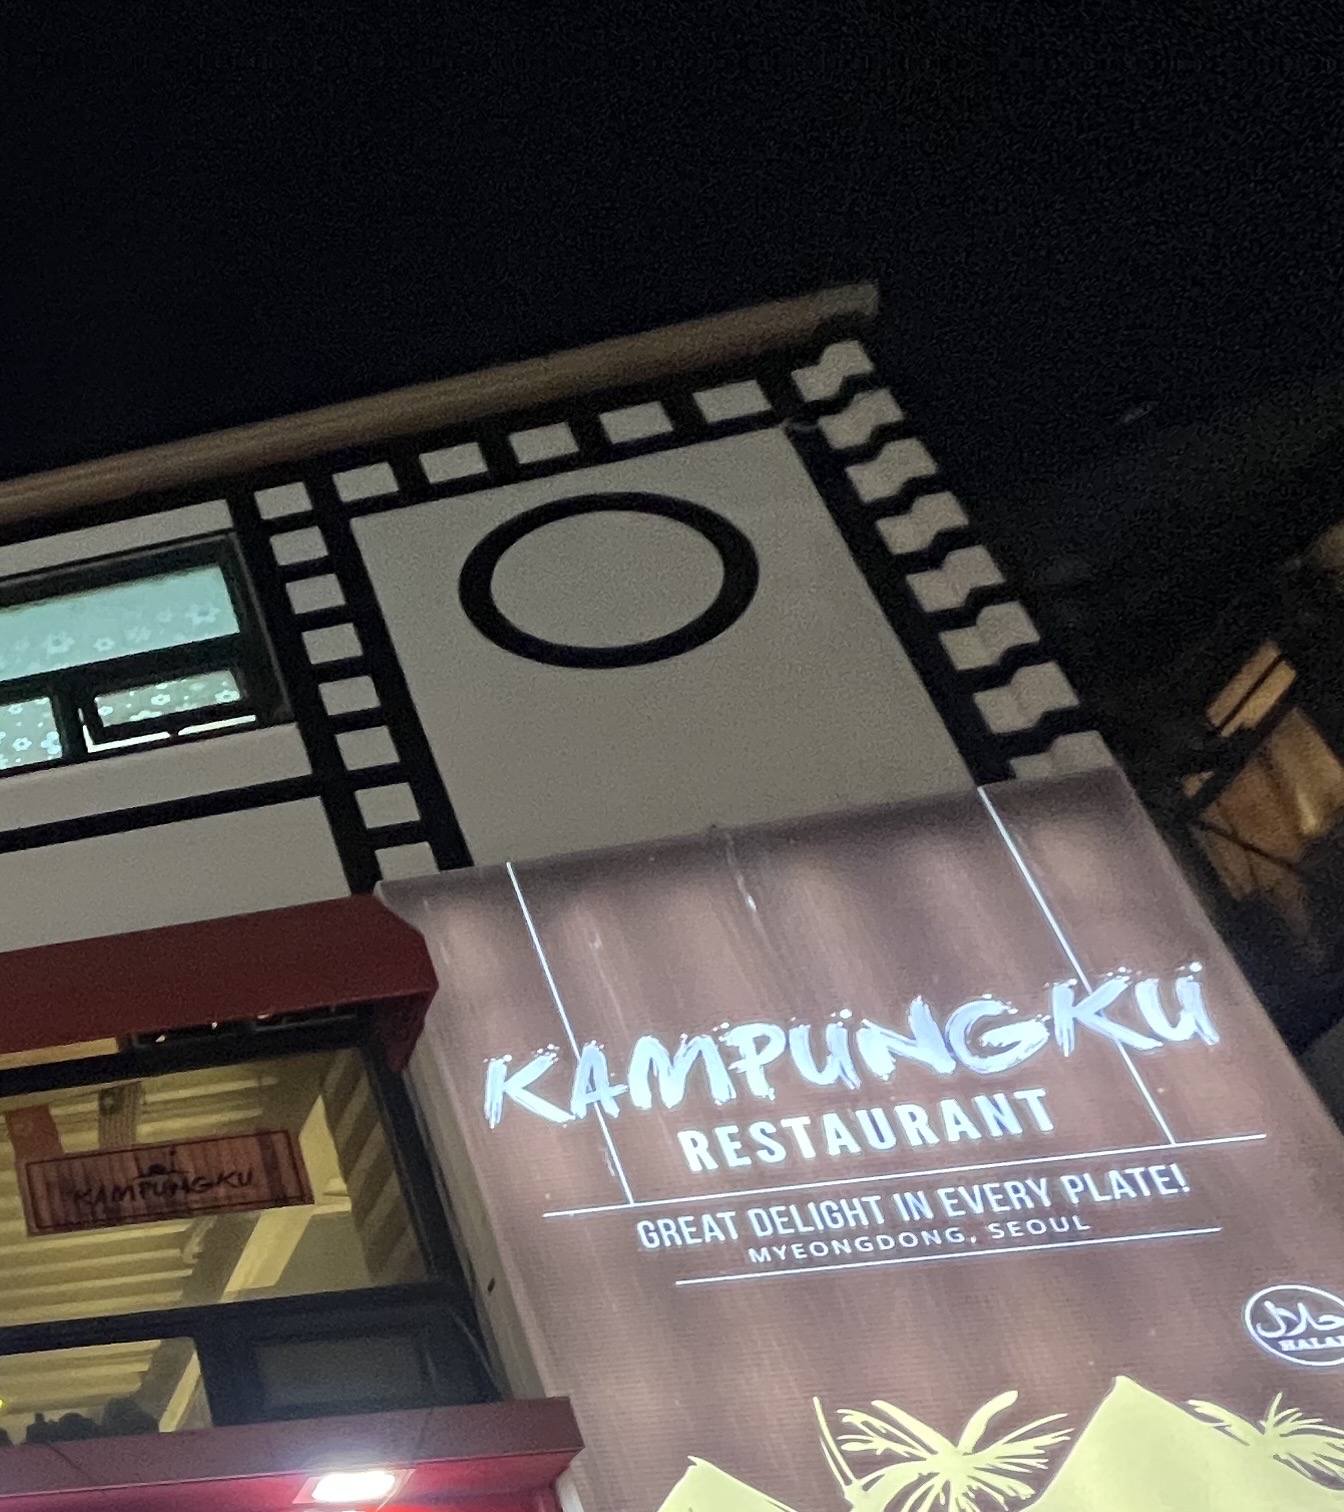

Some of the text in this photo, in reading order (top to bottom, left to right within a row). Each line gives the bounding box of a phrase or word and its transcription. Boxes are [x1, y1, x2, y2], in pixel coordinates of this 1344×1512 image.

[481, 961, 1222, 1128] KAMPUNGKU
[676, 1086, 1058, 1174] RESTAURANT
[636, 1163, 1191, 1251] GREAT DELIGHT IN EVERY PLATE!
[747, 1214, 1093, 1265] MYEONGDONG, SEOUL
